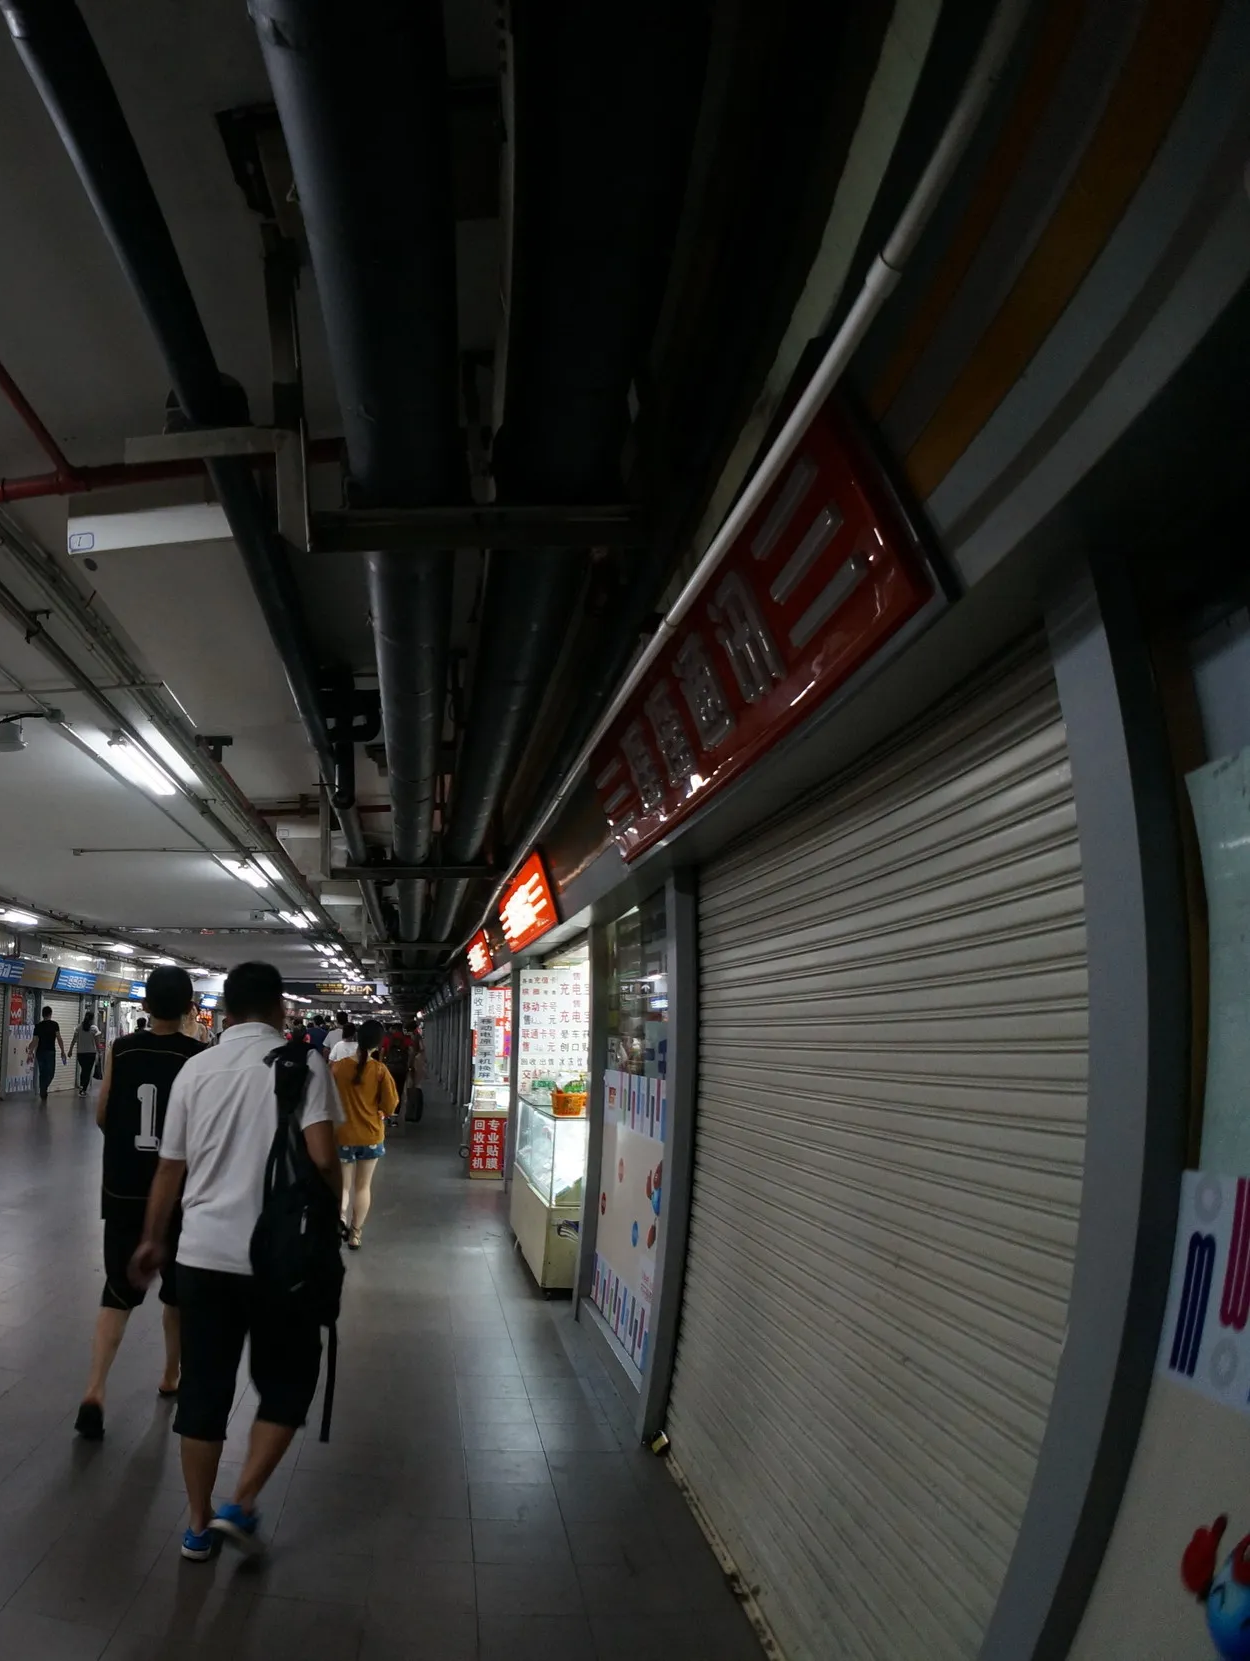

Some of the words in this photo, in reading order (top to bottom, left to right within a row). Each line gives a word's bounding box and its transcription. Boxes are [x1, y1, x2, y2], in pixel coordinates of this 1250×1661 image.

[522, 1001, 558, 1012] 移动卡号
[521, 1028, 558, 1039] 联通卡号
[134, 1083, 160, 1151] 1
[472, 1119, 486, 1169] 回收手机
[485, 1119, 501, 1170] 专业贴膜
